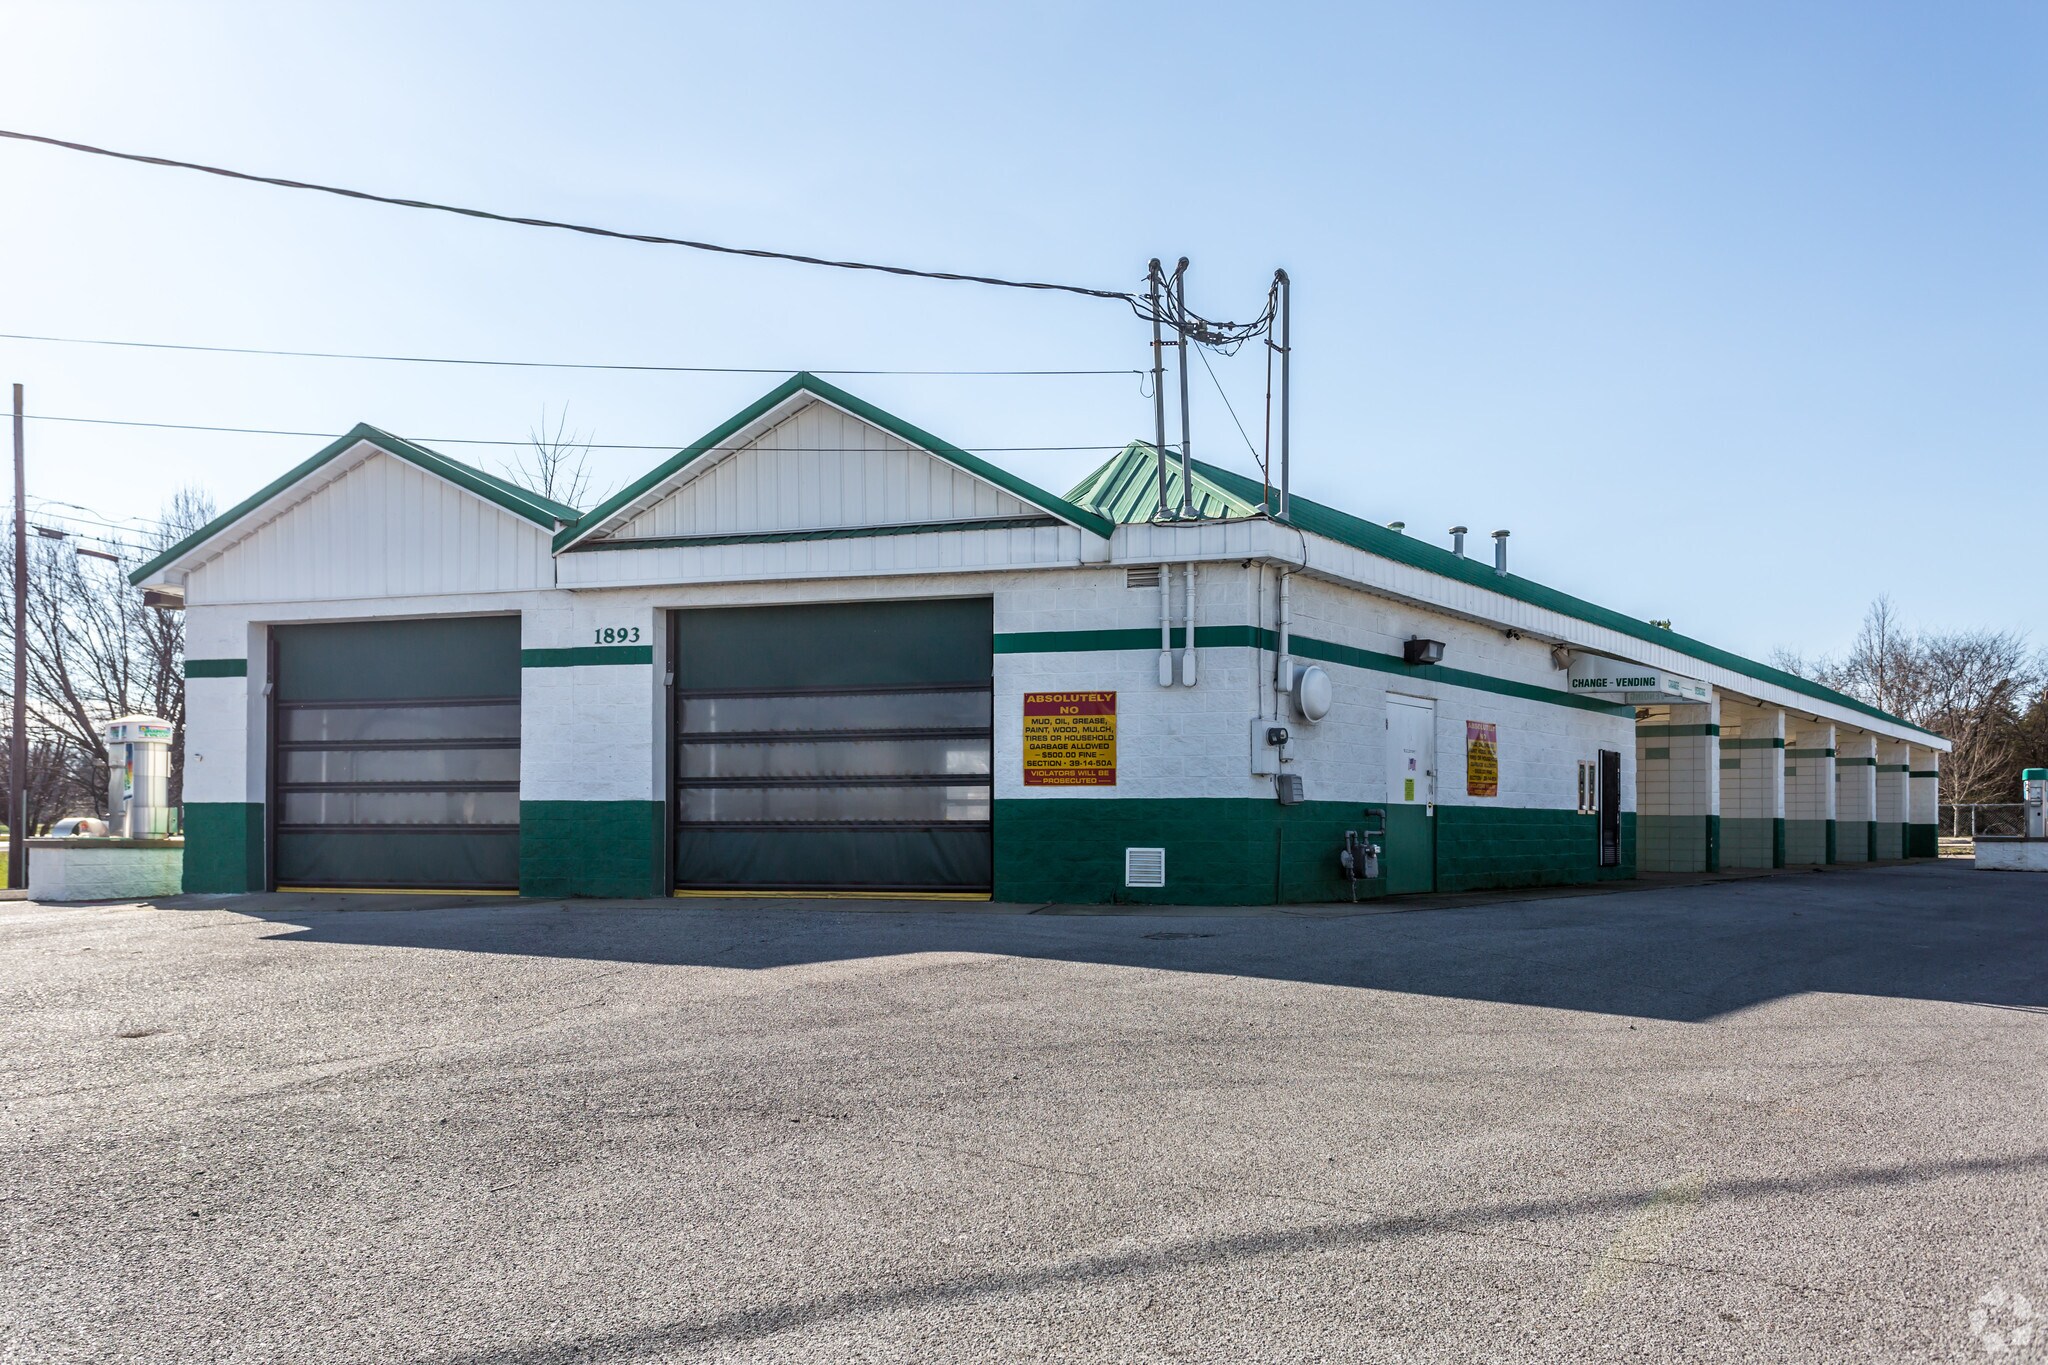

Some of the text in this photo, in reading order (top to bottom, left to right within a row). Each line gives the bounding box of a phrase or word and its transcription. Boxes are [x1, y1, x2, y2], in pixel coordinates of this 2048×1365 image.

[594, 627, 640, 644] 1893
[1572, 678, 1608, 688] CHANGE
[1616, 677, 1655, 687] VENDING
[1027, 694, 1113, 702] ABSOLUTELY
